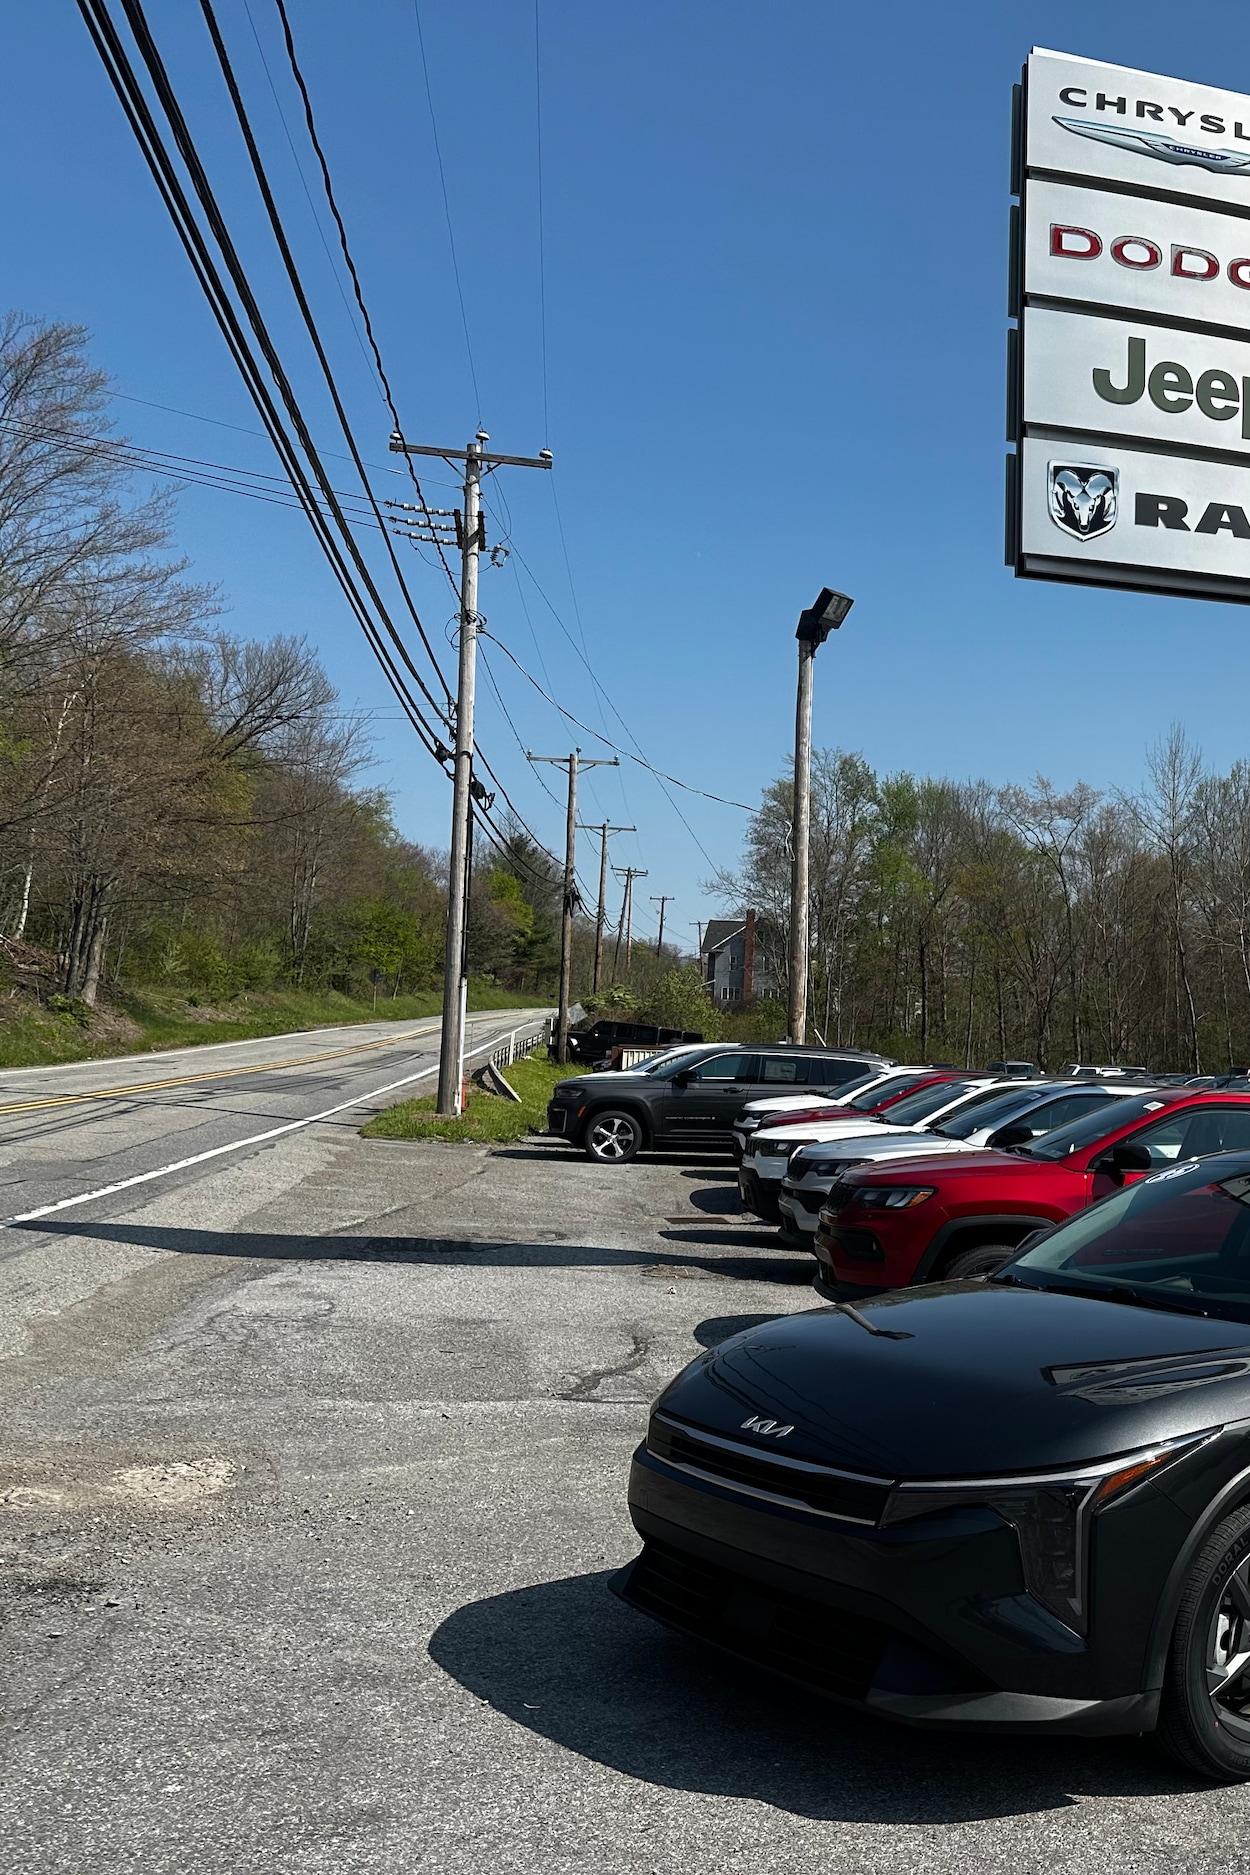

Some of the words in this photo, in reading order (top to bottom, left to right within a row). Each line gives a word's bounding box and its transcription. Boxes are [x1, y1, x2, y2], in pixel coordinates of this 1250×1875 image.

[1168, 145, 1222, 160] CHRYSLER
[740, 1415, 795, 1438] KIA
[1211, 1536, 1250, 1587] DORAL
